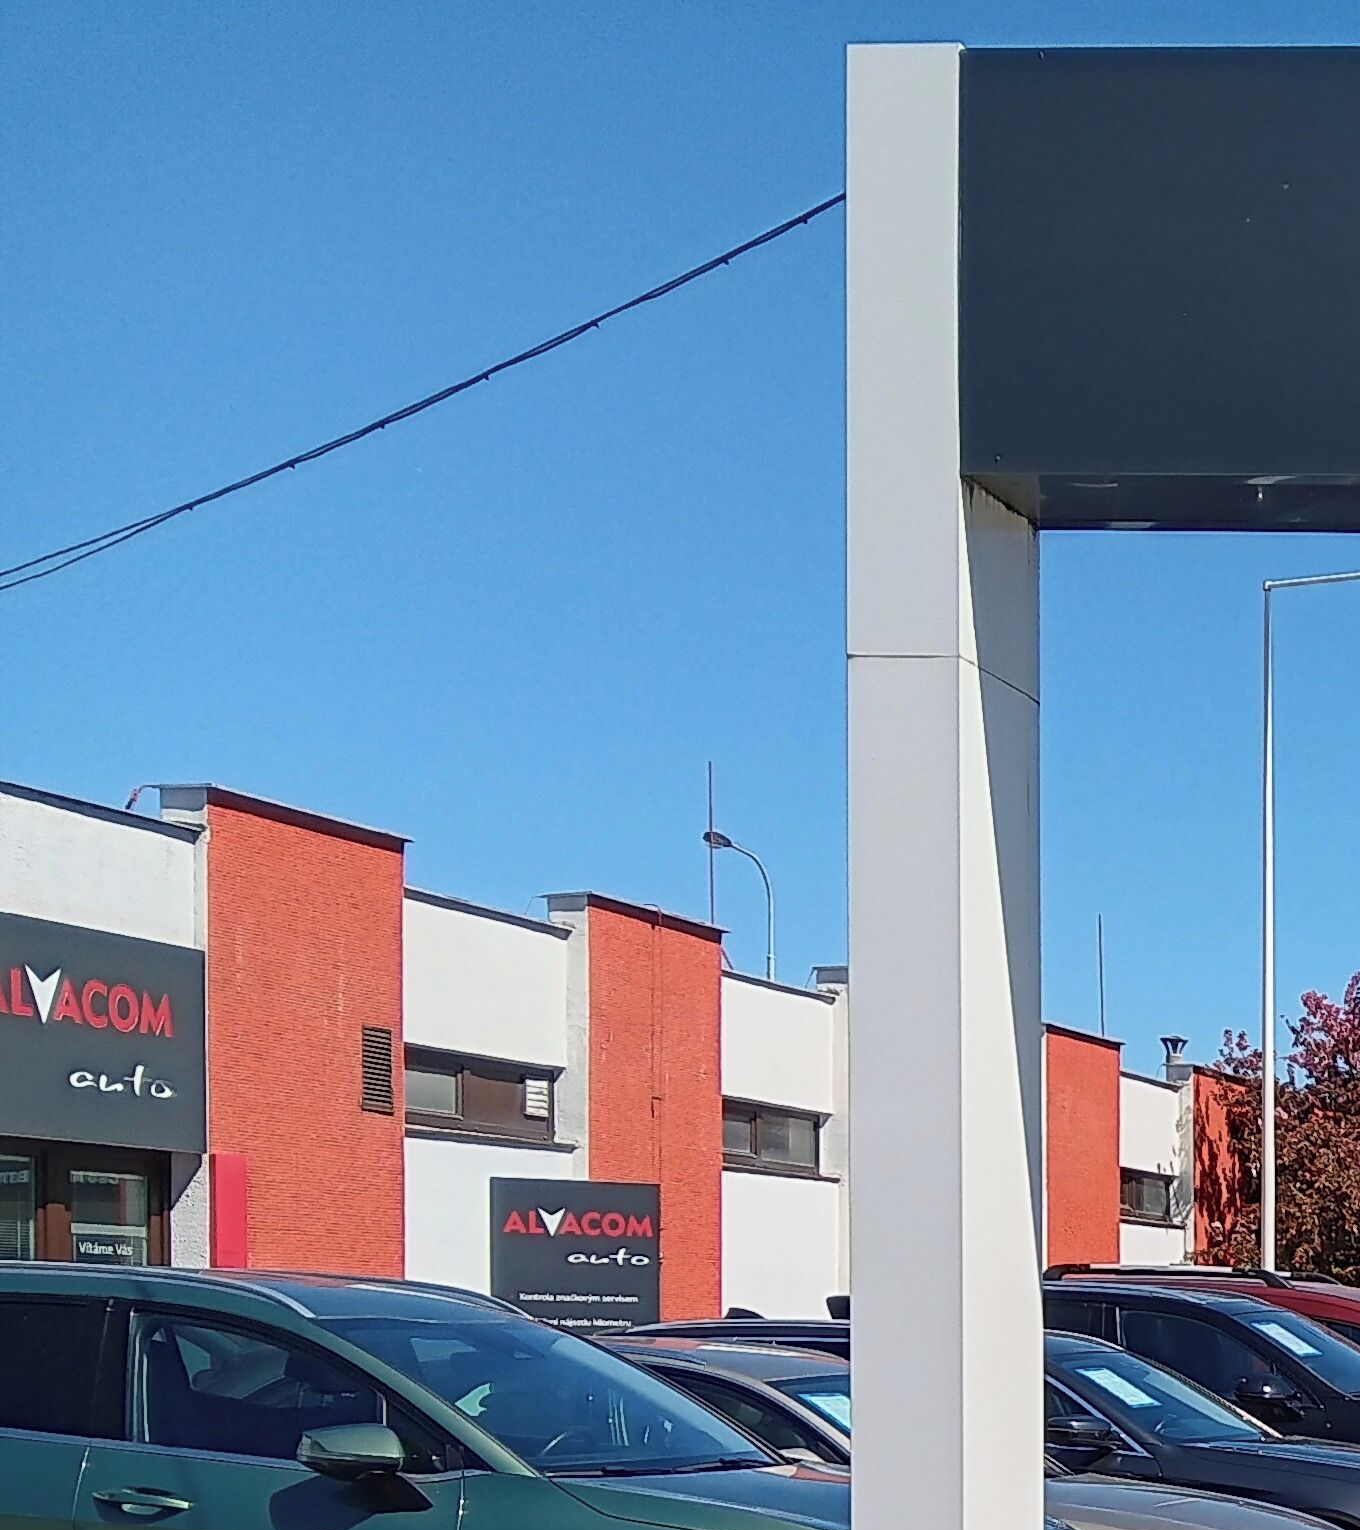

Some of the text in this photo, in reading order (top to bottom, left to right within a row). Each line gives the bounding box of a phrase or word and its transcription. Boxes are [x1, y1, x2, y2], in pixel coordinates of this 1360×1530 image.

[69, 1064, 177, 1099] auto
[503, 1208, 653, 1238] ALVACOM
[567, 1248, 650, 1266] auto
